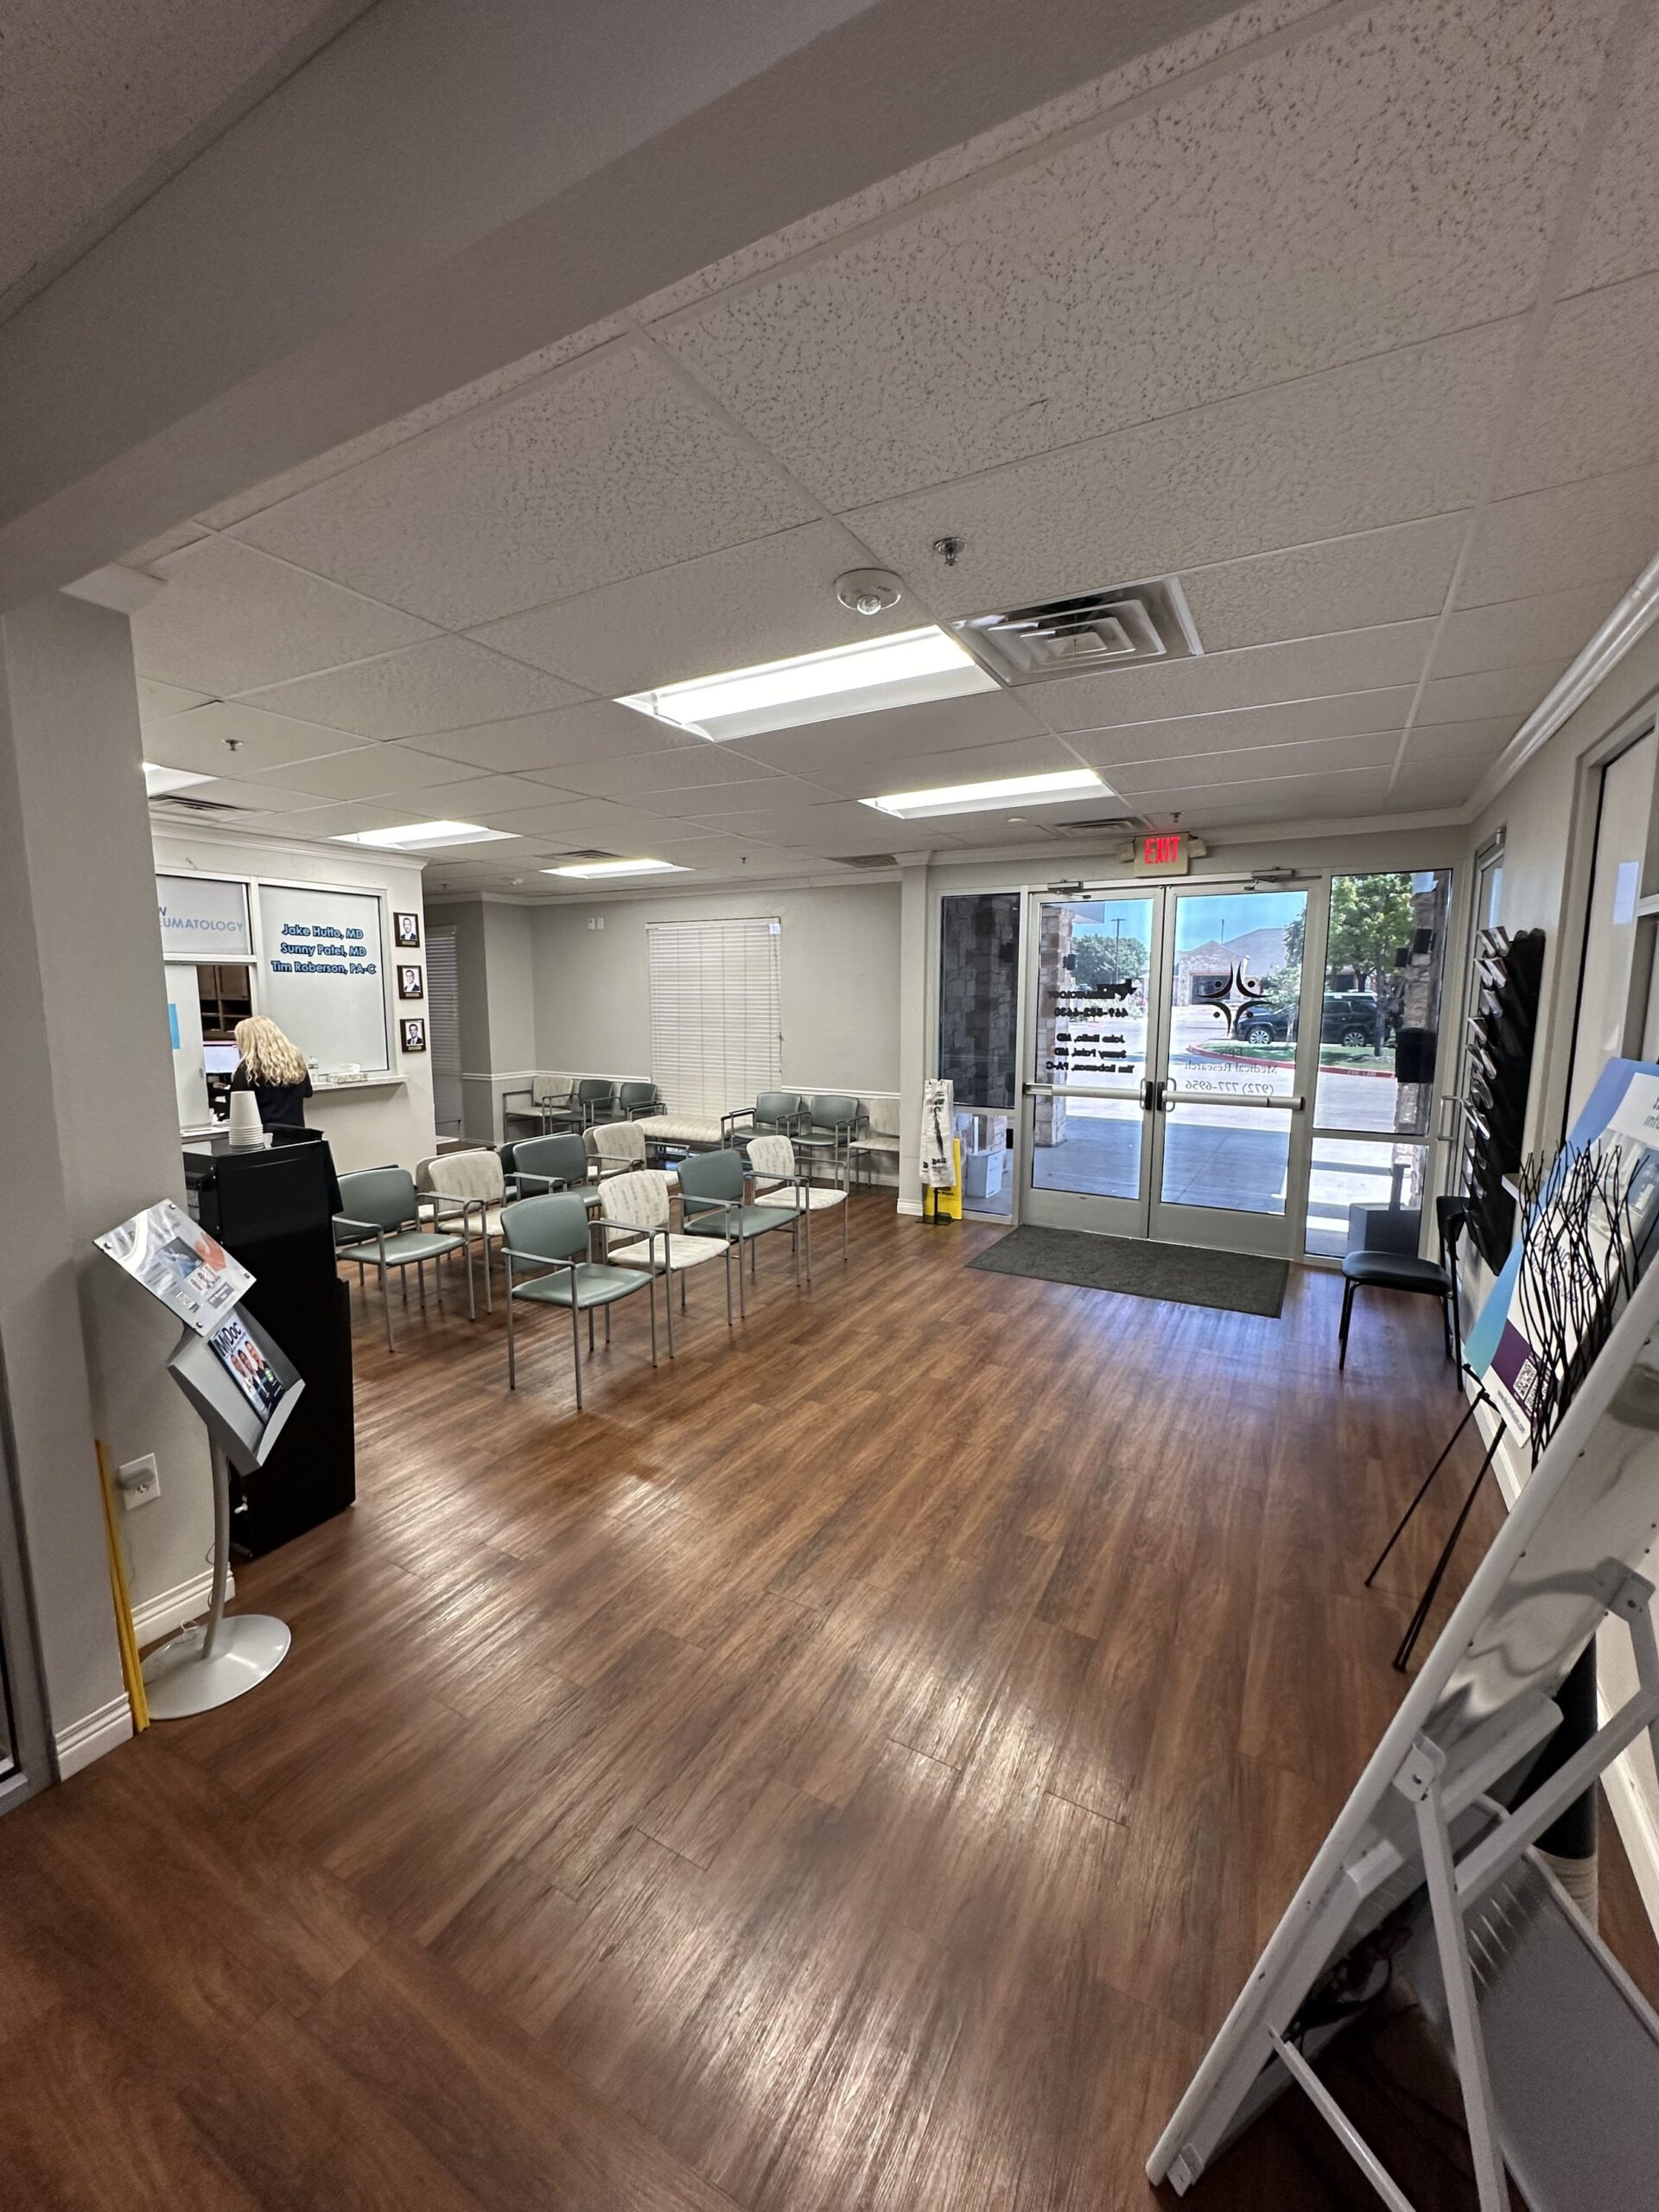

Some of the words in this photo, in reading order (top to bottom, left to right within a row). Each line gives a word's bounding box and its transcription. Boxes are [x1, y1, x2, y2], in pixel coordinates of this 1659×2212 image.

[1145, 836, 1180, 864] EXIT
[161, 917, 243, 931] UMATOLOGY
[282, 924, 310, 936] Jake
[313, 925, 344, 939] Hutto,
[346, 928, 364, 939] MD
[281, 942, 315, 957] Sunny
[317, 944, 347, 957] Patel,
[349, 946, 367, 957] MD
[271, 961, 292, 972] Tim
[295, 962, 347, 975] Roberson,
[350, 963, 377, 975] PA-C
